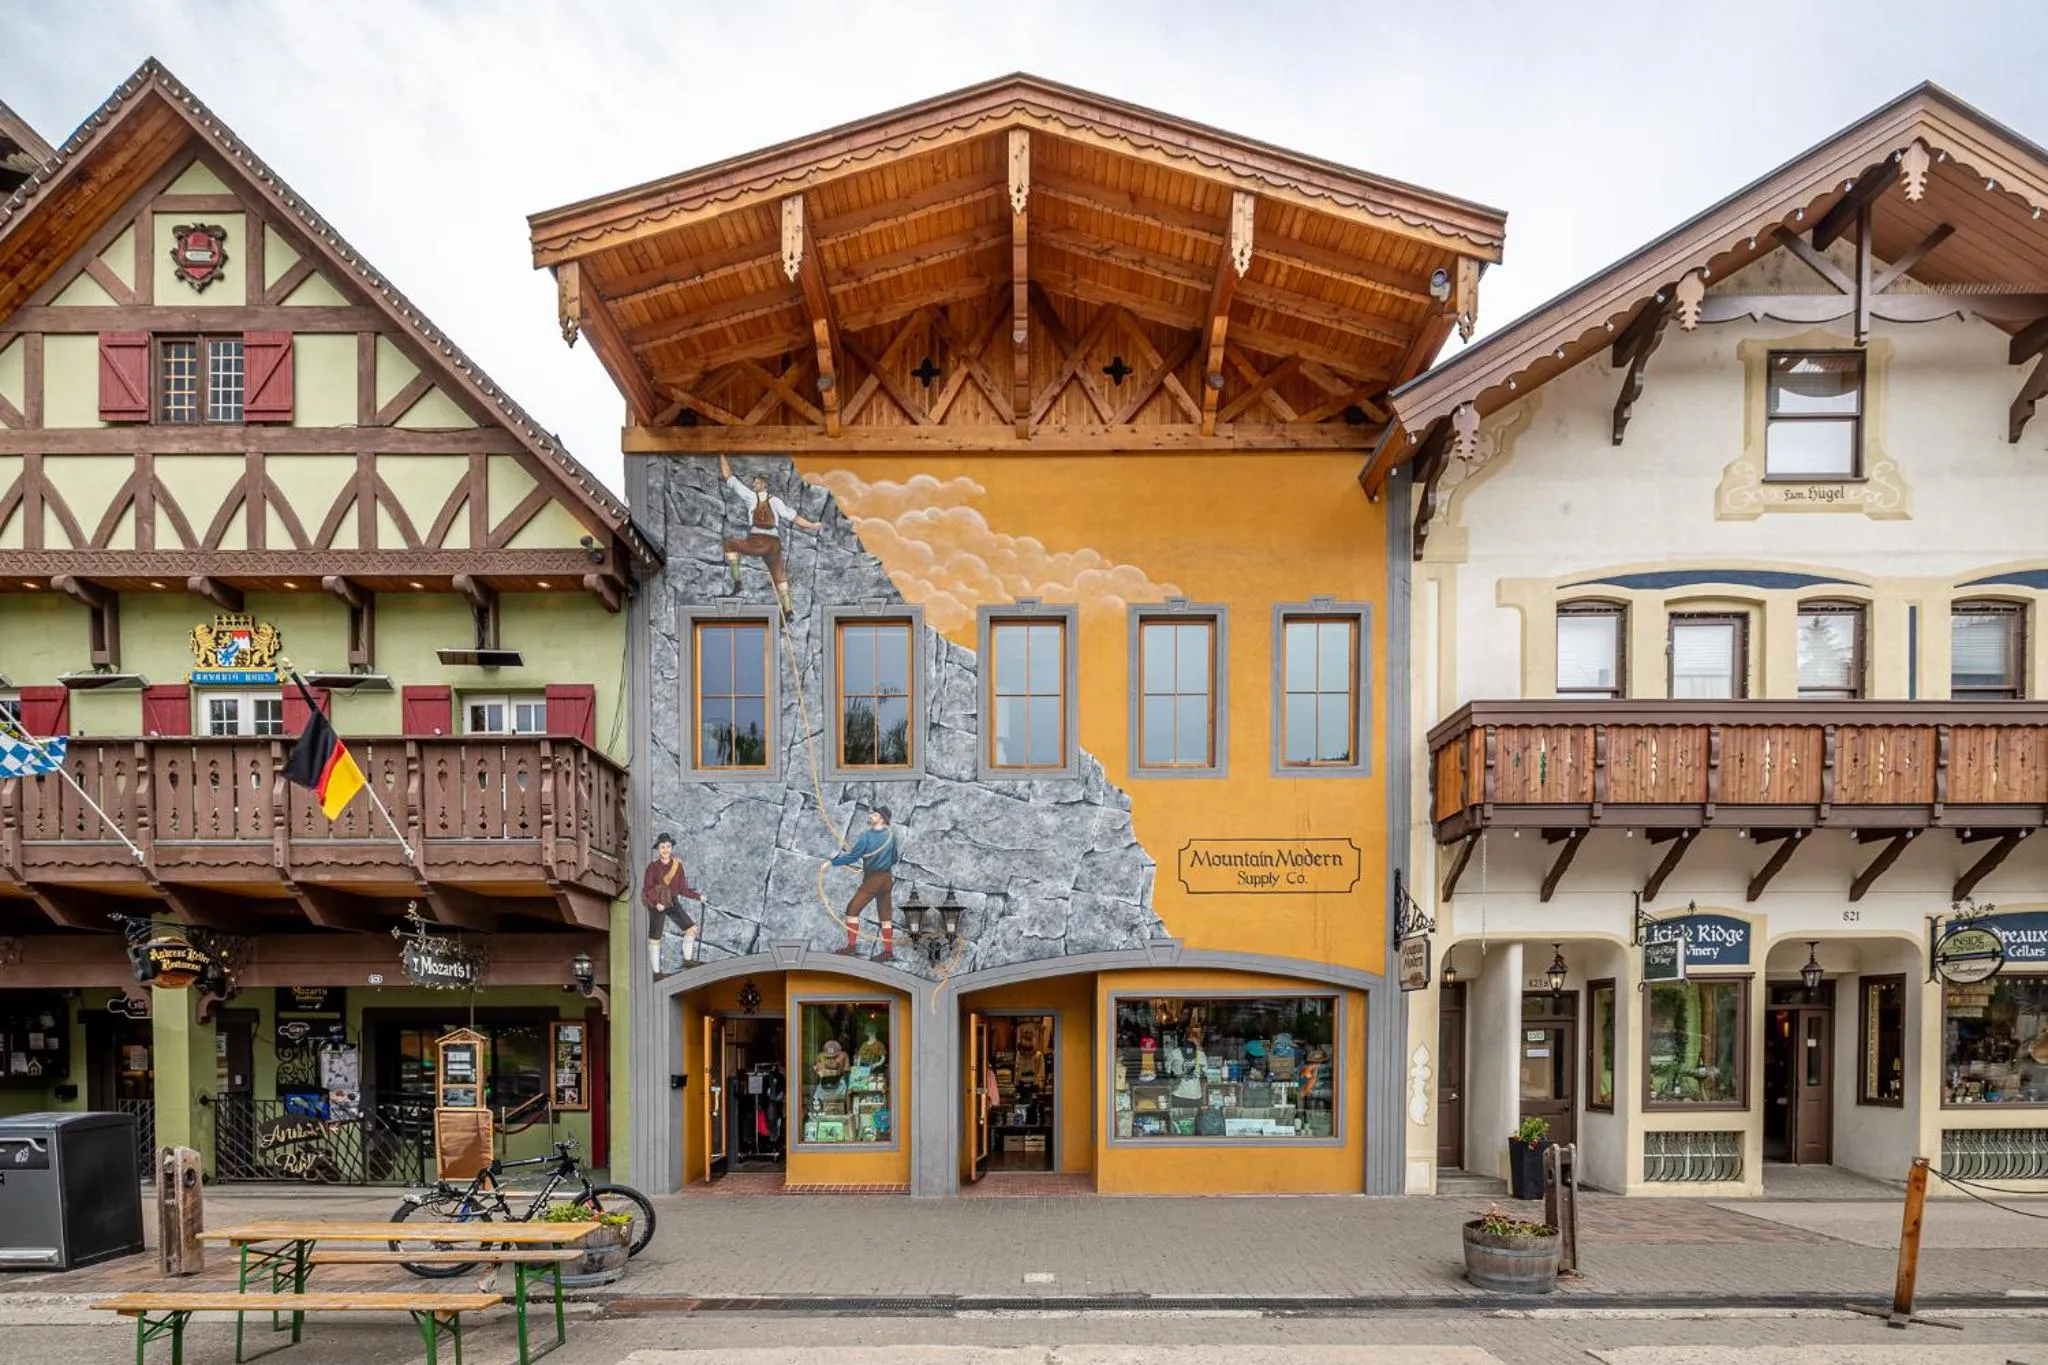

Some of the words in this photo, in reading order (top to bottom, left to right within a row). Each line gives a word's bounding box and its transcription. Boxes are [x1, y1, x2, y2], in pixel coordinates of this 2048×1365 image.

[1189, 850, 1274, 867] Mountain
[1275, 849, 1343, 867] Modern
[1237, 871, 1280, 888] Supply
[1286, 871, 1309, 884] Co.
[1697, 924, 1745, 947] Ridge
[2008, 945, 2046, 957] Cellars
[420, 956, 465, 978] Mozart's
